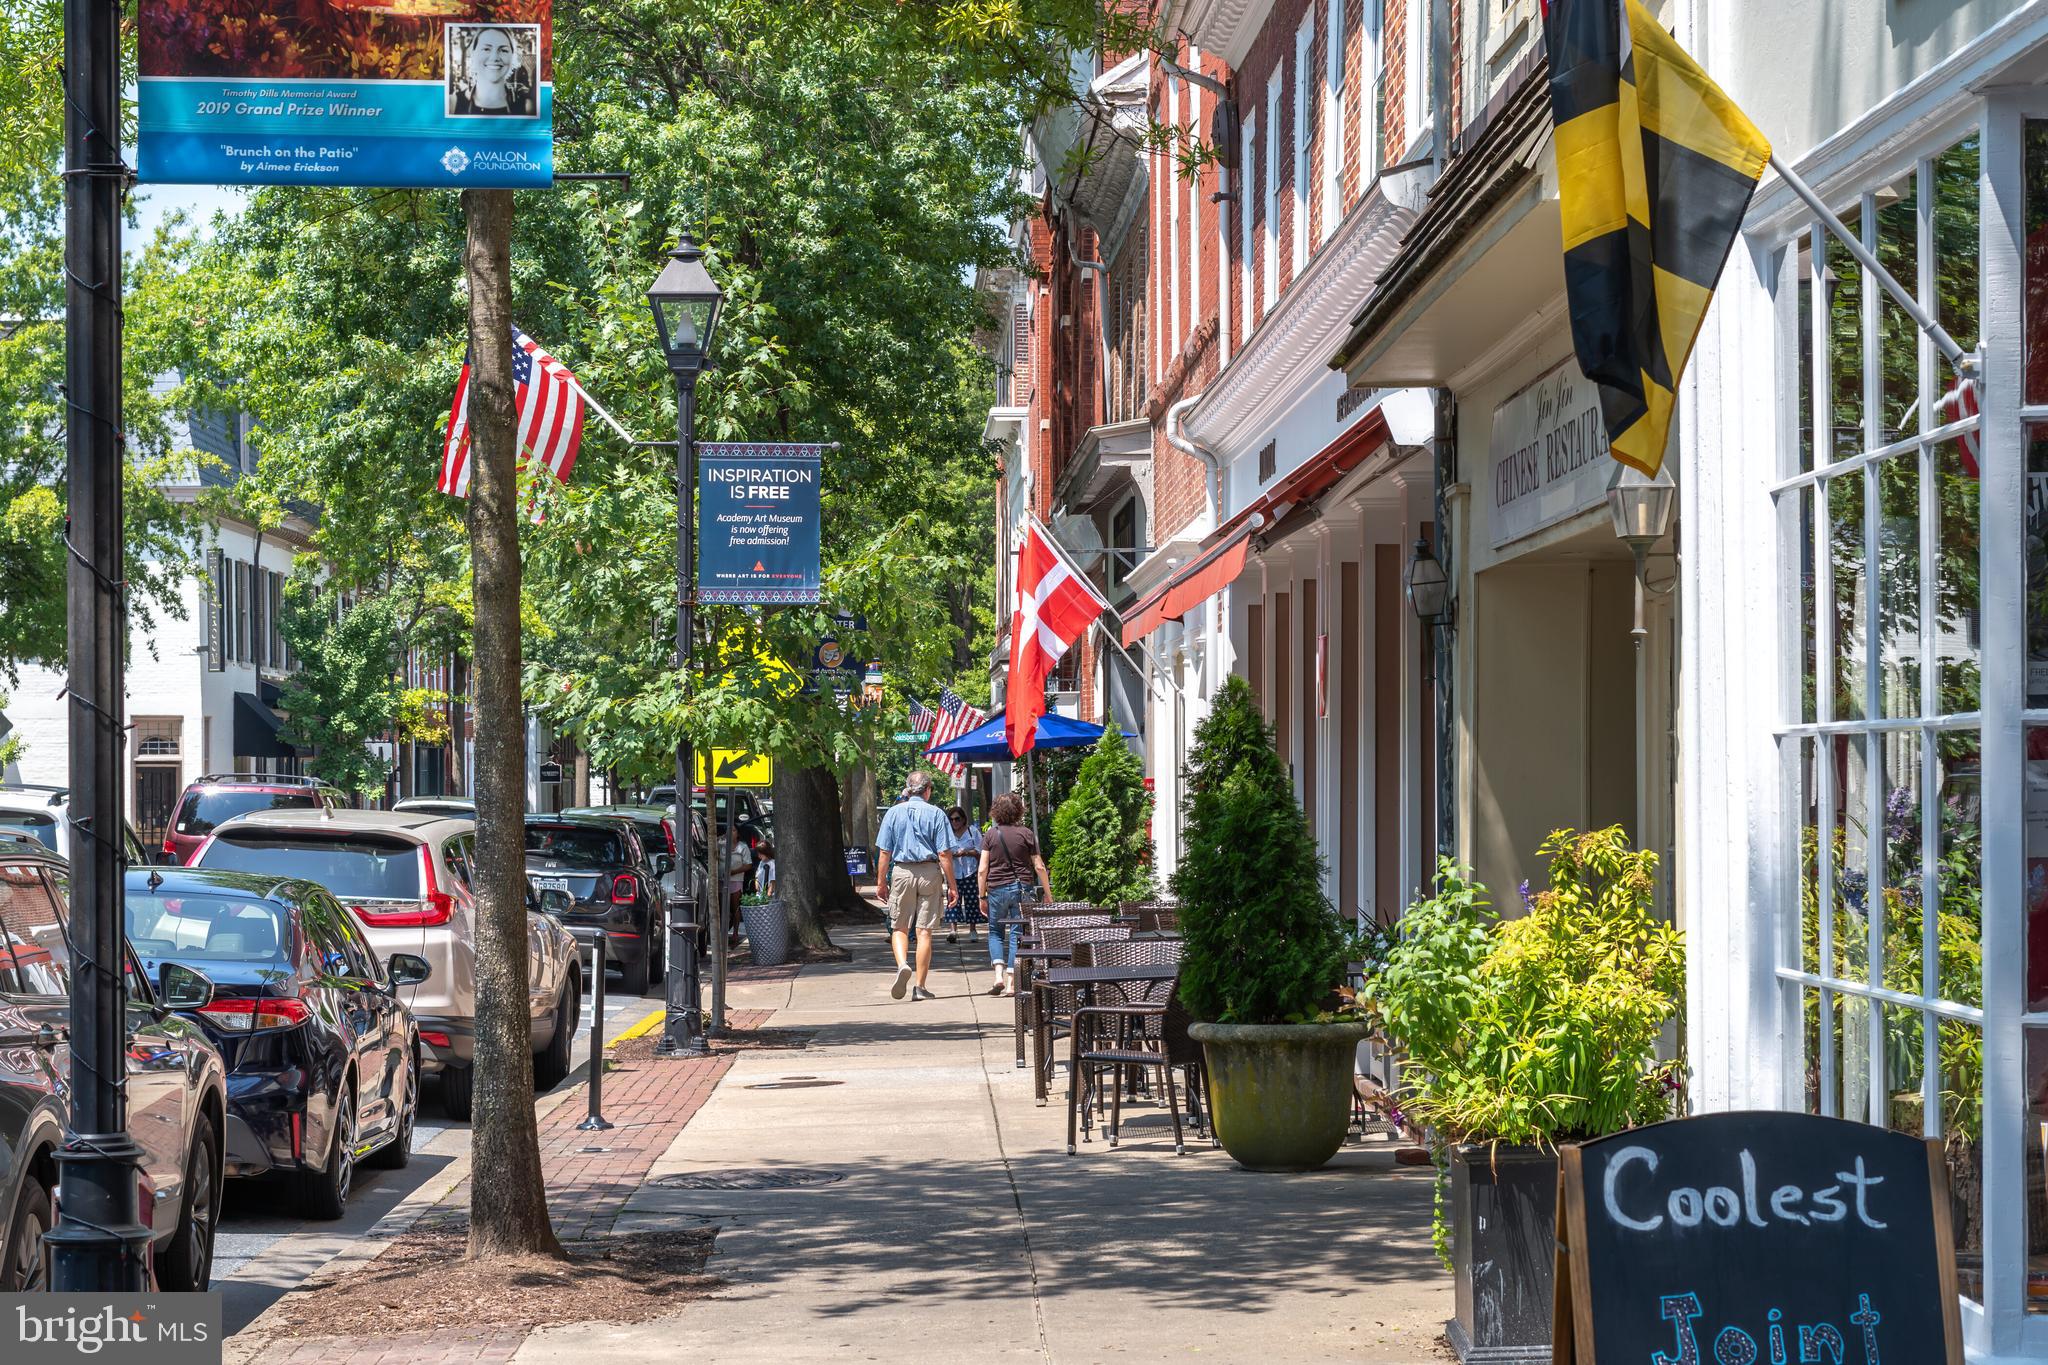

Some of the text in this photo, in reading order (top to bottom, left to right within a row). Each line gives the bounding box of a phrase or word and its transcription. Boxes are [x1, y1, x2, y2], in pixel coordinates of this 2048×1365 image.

[222, 88, 357, 99] Timothy Dills Memorial Award
[196, 102, 382, 117] 2019 Grand Prize Winner
[220, 144, 358, 159] "Brunch on the Patio"
[473, 151, 527, 162] AVALON
[240, 161, 339, 174] by Aimee Erickson
[473, 161, 541, 172] FOUNDATION
[1495, 406, 1609, 508] CHINESE RESTAURA
[708, 468, 812, 483] INSPIRATION
[730, 485, 790, 499] IS FREE
[717, 513, 803, 524] Academy Art Museum
[731, 525, 738, 534] is
[758, 524, 789, 536] offering
[729, 536, 790, 547] free admission!
[1603, 1145, 1887, 1232] Coolest
[1651, 1292, 1880, 1365] Joint
